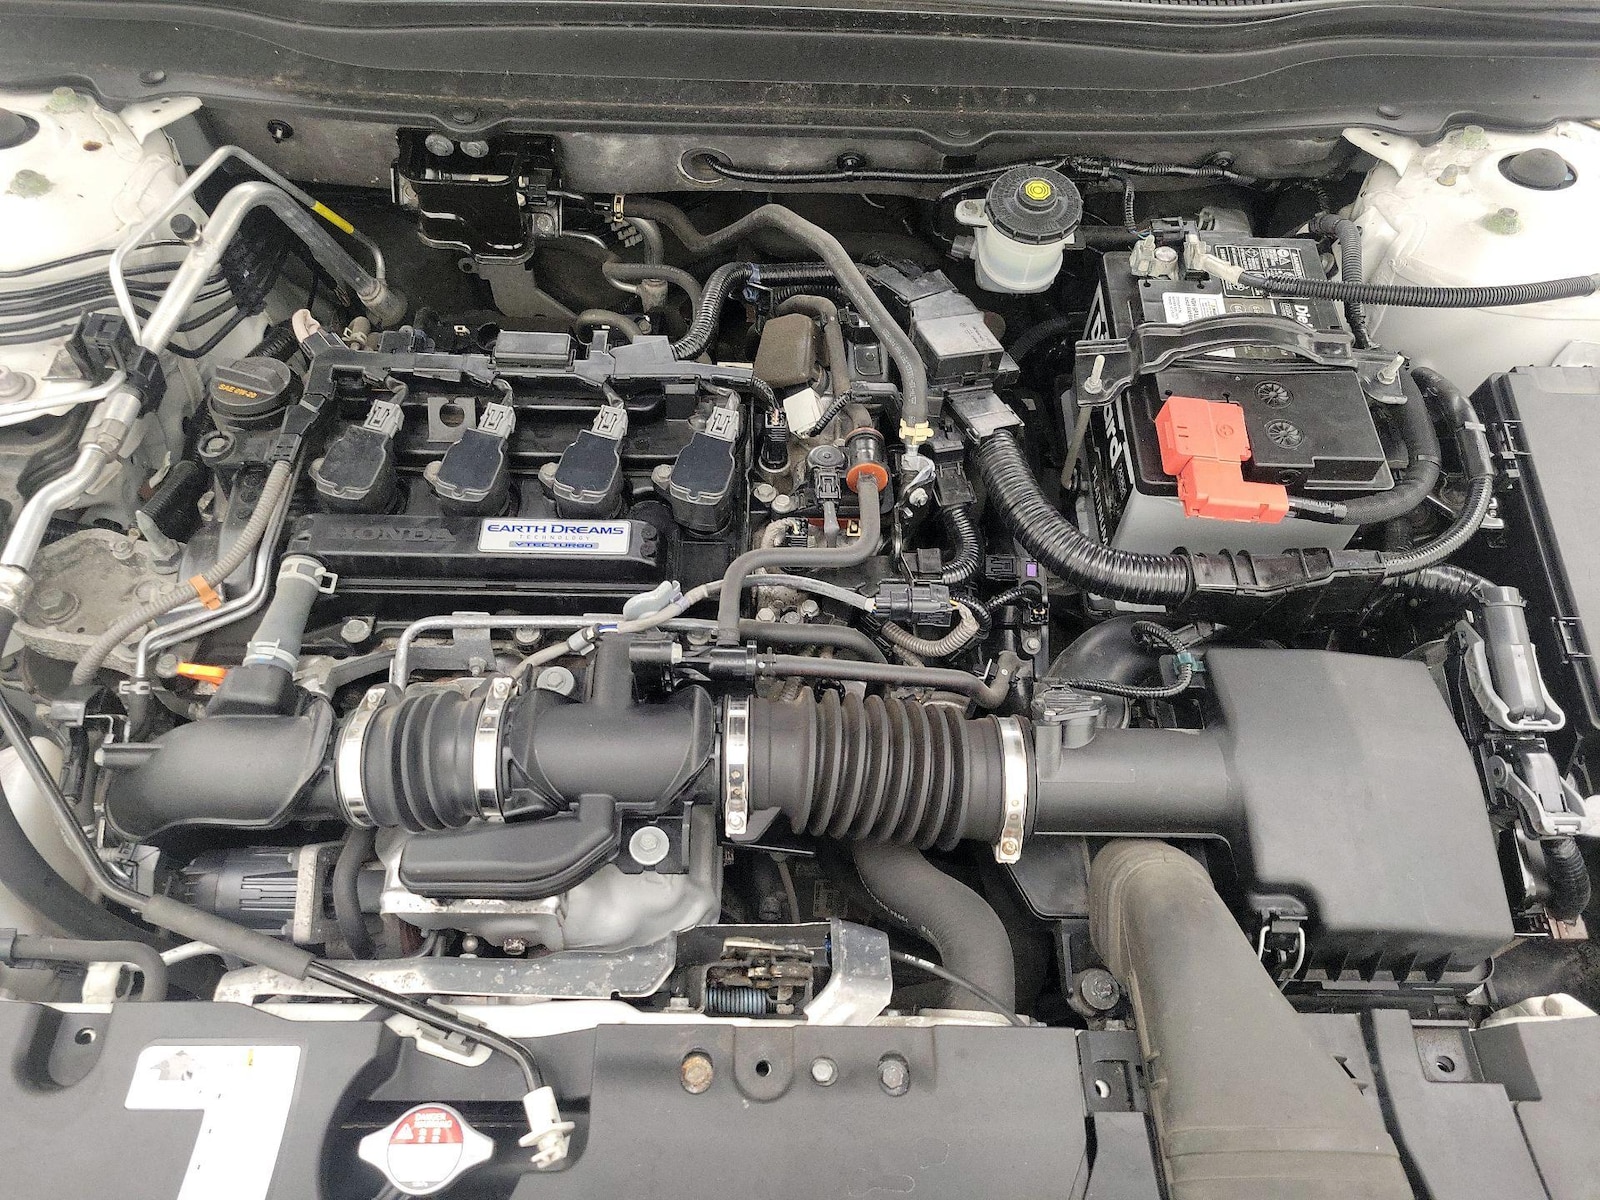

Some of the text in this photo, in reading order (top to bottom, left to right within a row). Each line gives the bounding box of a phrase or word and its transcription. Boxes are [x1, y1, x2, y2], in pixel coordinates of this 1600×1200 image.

[1092, 465, 1109, 546] PLATINUM
[487, 524, 624, 535] EARTH DREAMS
